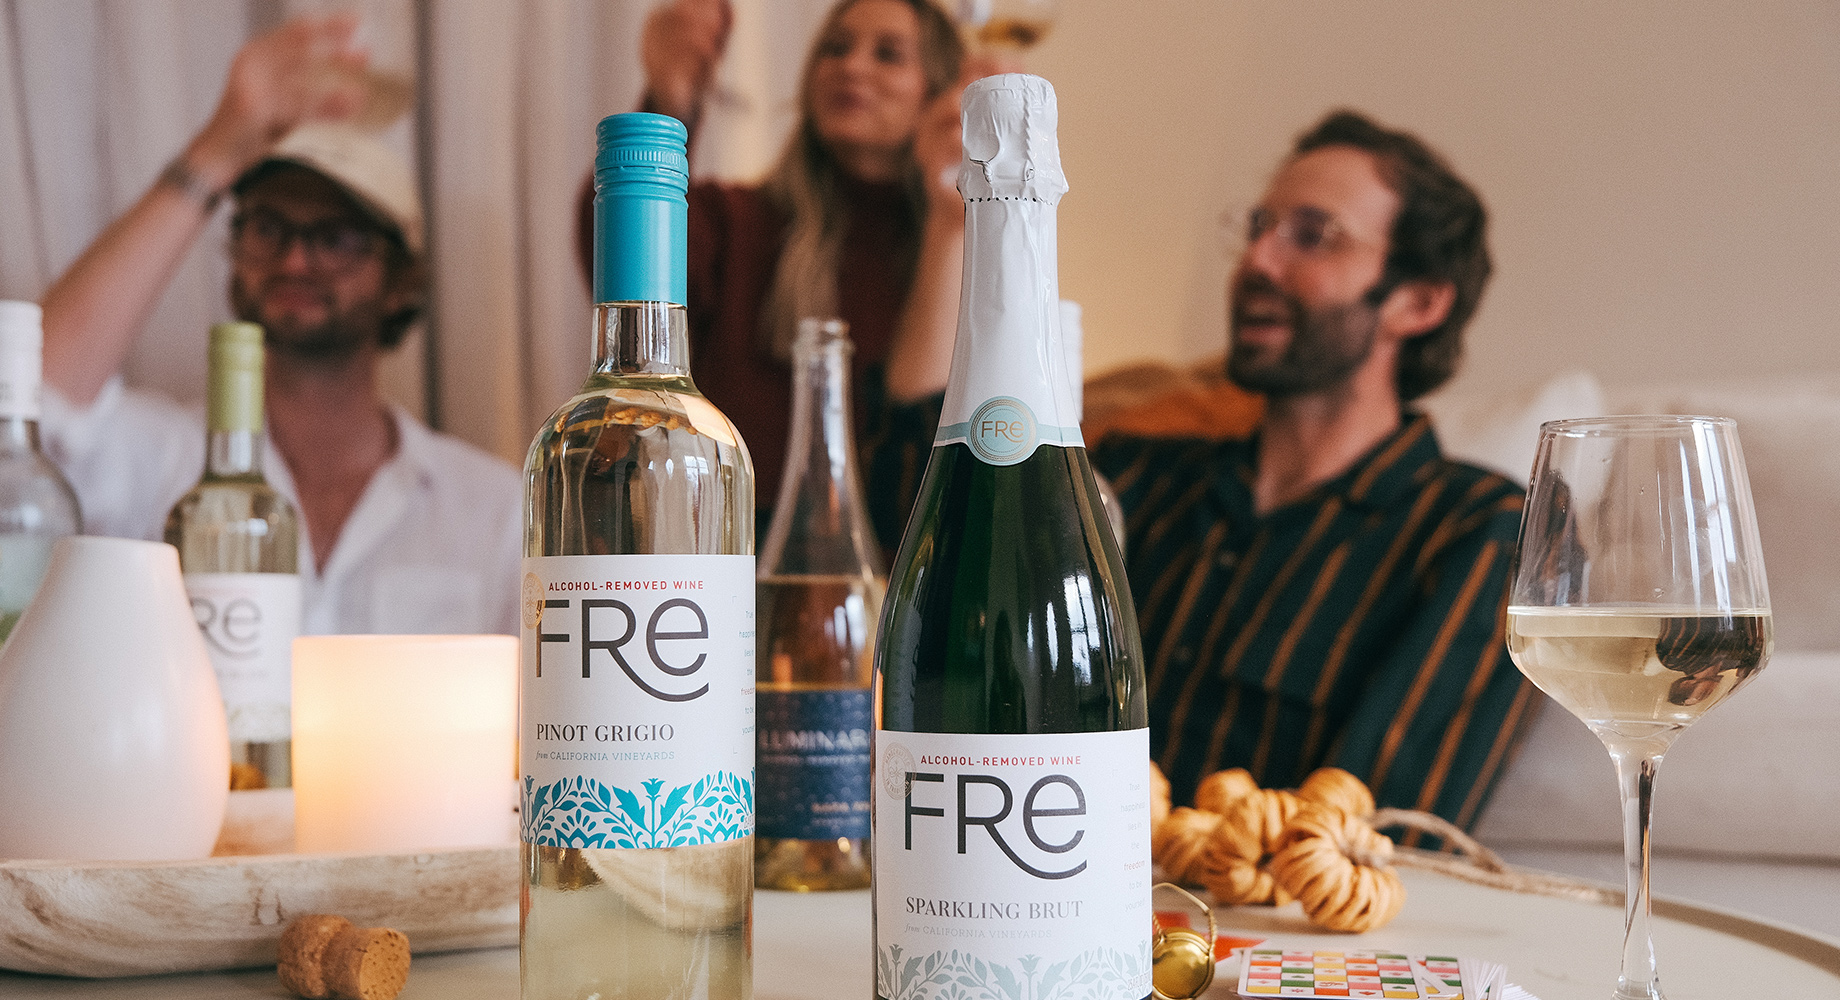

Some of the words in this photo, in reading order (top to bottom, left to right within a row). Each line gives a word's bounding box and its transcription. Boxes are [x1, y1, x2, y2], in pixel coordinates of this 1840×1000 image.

[982, 420, 1024, 443] FRe
[548, 580, 668, 592] ALCOHOL-REMOVED
[673, 580, 704, 590] WINE
[188, 597, 262, 661] Re
[536, 597, 710, 702] FRe
[536, 723, 588, 742] PINOT
[594, 723, 675, 742] GRIGIO
[757, 729, 870, 751] LUMINAR
[550, 751, 609, 761] CALIFORNIA
[612, 751, 675, 761] VINEYARDS
[920, 755, 1045, 767] ALCOHOL-REMOVED
[1050, 755, 1082, 766] WINE
[904, 771, 1088, 880] FRe
[905, 896, 1020, 920] SPARKLING
[1029, 900, 1084, 919] BRUT
[922, 926, 986, 938] CALIFORNIA
[989, 929, 1052, 940] VINEYARDS
